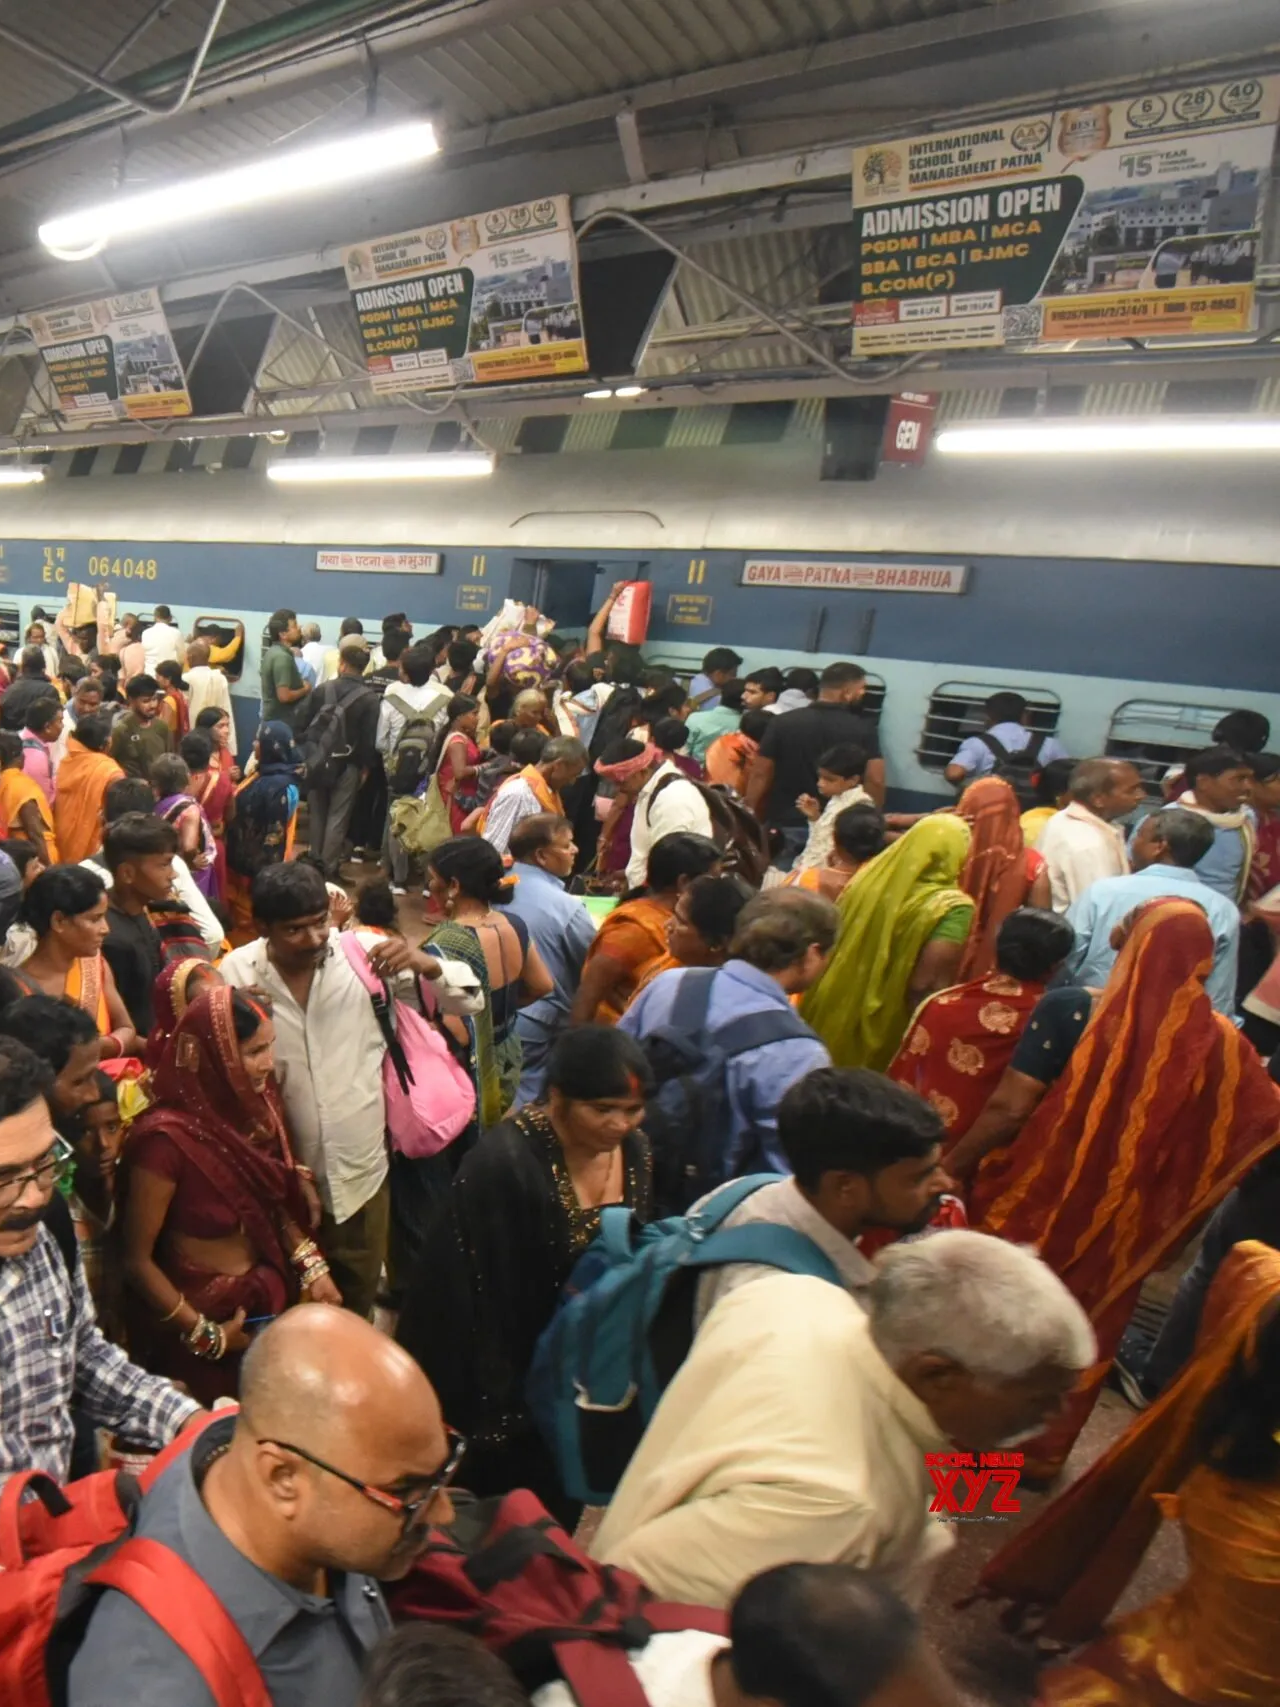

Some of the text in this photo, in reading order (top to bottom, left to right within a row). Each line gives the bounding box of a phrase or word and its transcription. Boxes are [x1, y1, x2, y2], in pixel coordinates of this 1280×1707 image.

[1228, 82, 1255, 98] 40
[908, 128, 1006, 156] INTERNATIONAL
[908, 148, 974, 171] SCHOOL OF
[908, 151, 1043, 184] MANAGEMENT PATNA
[1122, 155, 1153, 178] 15
[861, 183, 1062, 238] ADMISSION OPEN
[860, 220, 1042, 256] PGDM MBA MCA
[860, 243, 1030, 276] BBA BCA BJMC
[355, 273, 465, 311] ADMISSION OPEN
[860, 269, 956, 296] B.COM(P)
[396, 304, 423, 318] MBA
[429, 298, 458, 312] MCA
[896, 420, 921, 450] GEN
[88, 556, 157, 581] 064048
[355, 554, 381, 566] पटना
[747, 565, 952, 589] GAYA PATNA BHABHUA
